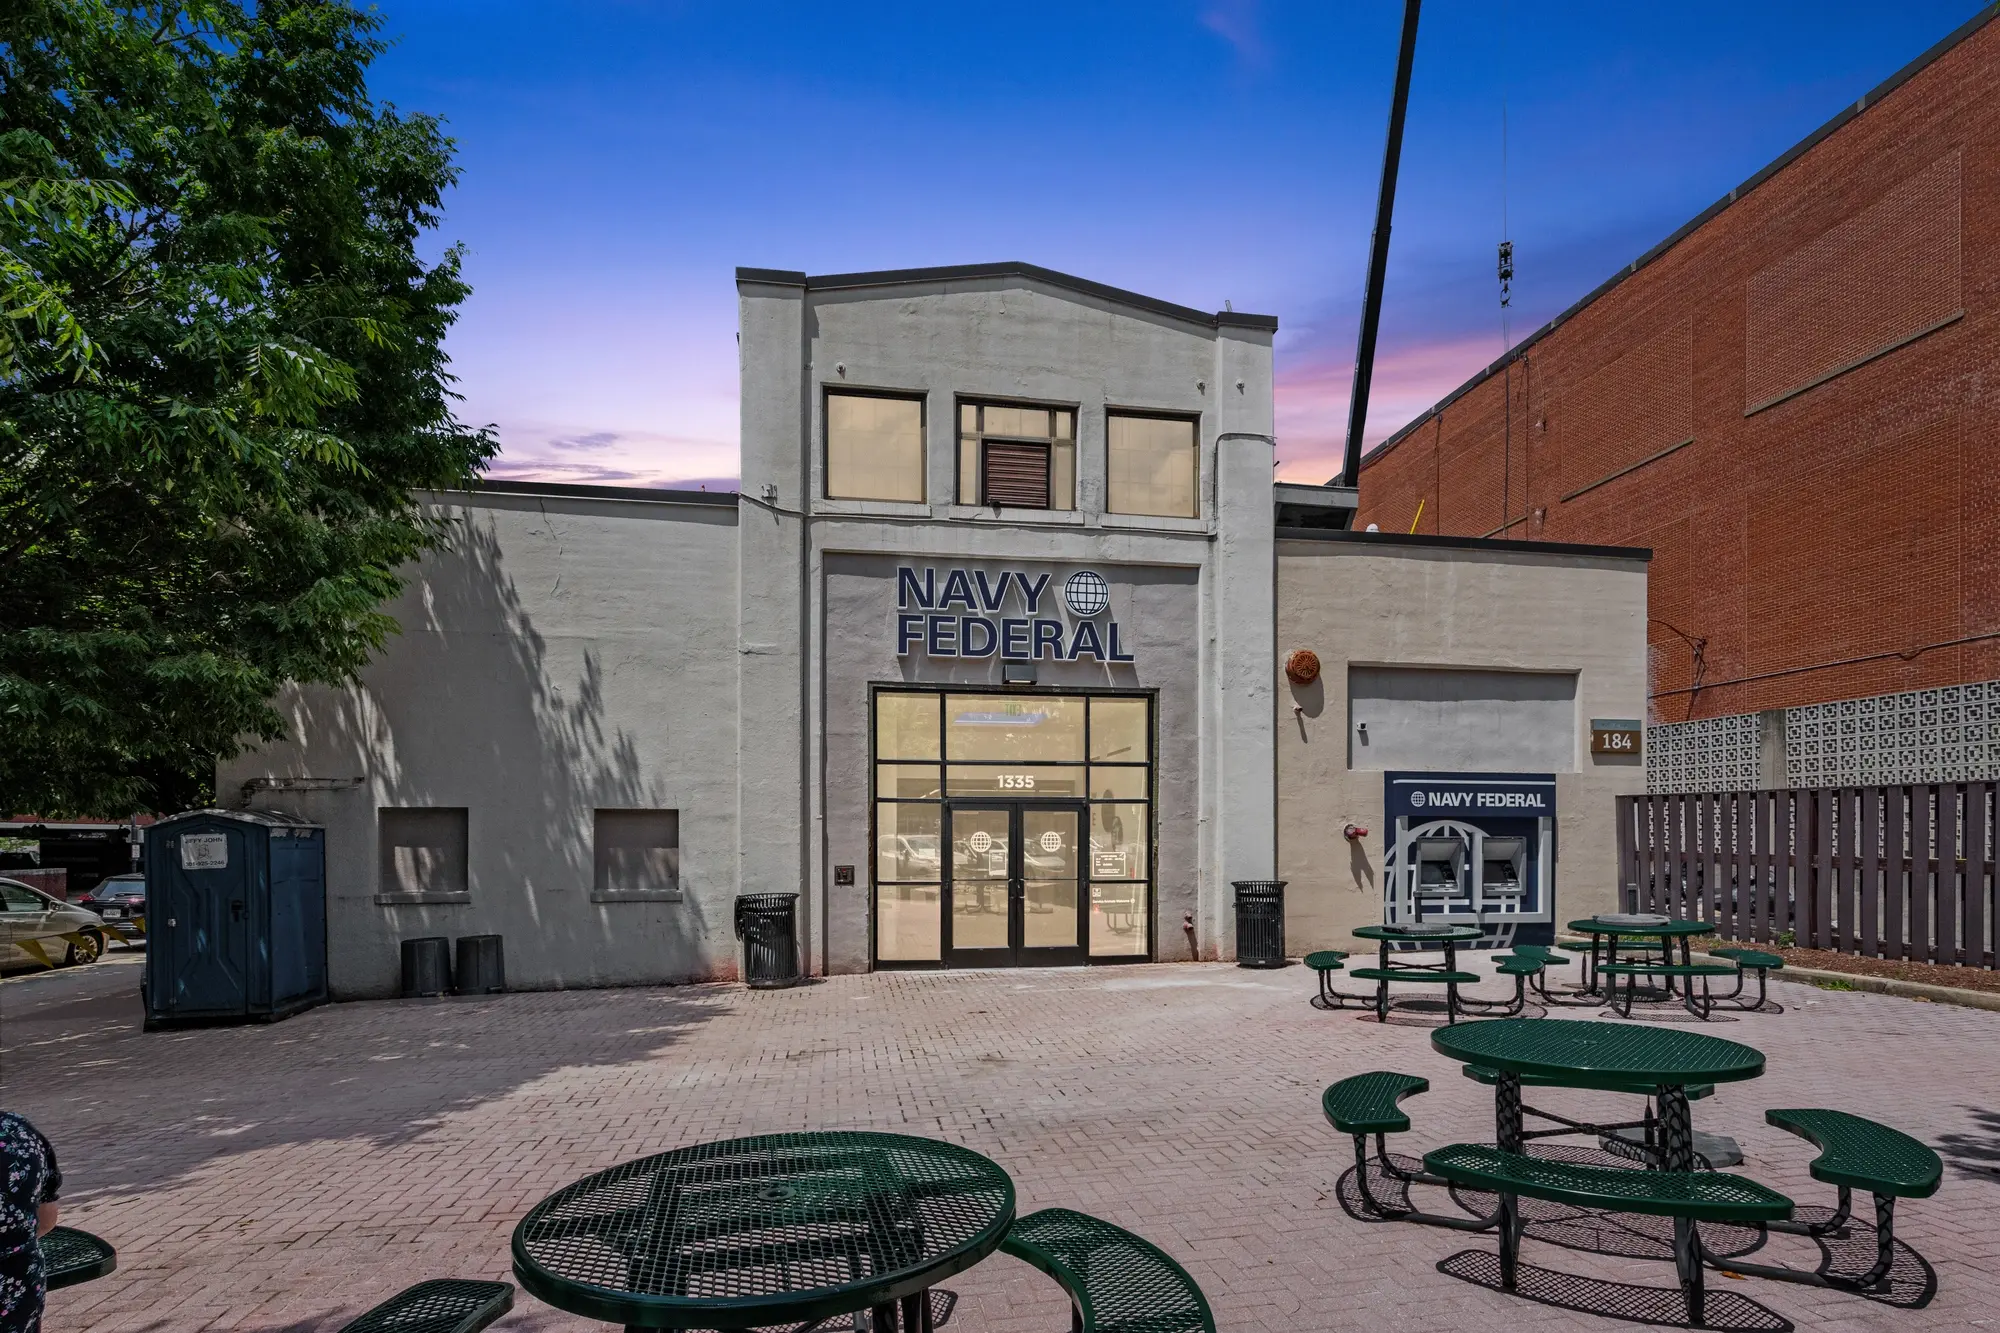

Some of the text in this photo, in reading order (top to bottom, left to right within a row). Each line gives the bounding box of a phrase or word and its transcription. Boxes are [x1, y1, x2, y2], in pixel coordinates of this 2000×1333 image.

[897, 566, 1052, 615] NAVY
[897, 613, 1135, 662] FEDERAL
[1602, 733, 1632, 749] 184
[997, 775, 1035, 788] 1335
[1428, 792, 1546, 808] NAVY FEDERAL
